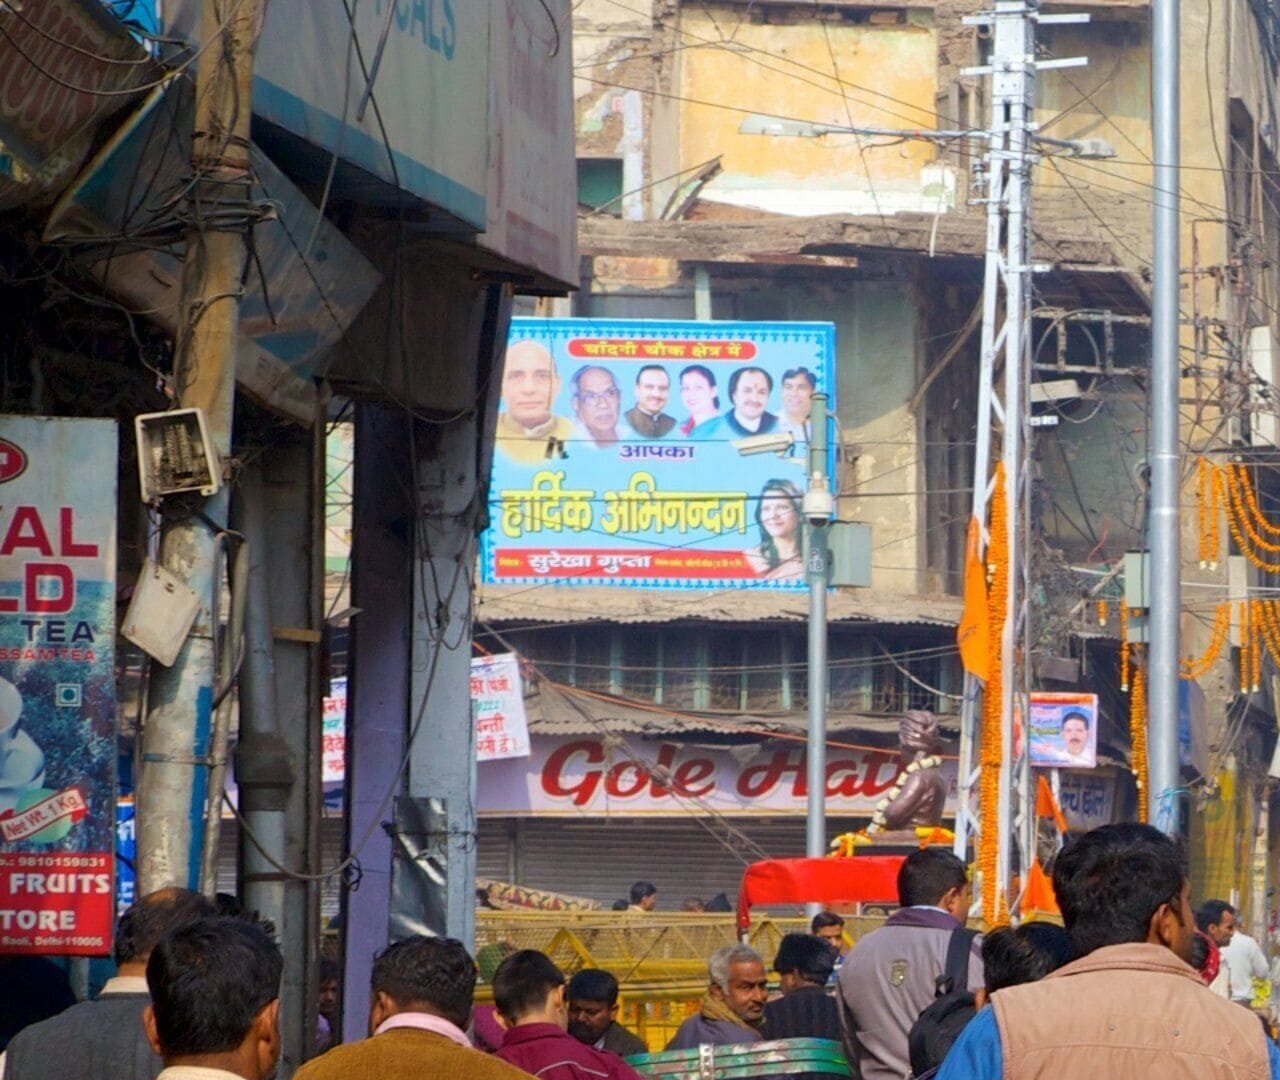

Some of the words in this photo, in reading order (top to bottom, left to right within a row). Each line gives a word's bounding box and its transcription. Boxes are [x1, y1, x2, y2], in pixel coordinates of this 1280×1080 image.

[620, 444, 695, 459] आपका
[501, 471, 595, 539] हार्दिक
[20, 620, 96, 644] TEA
[541, 740, 717, 806] Gole
[9, 872, 111, 895] FRUITS
